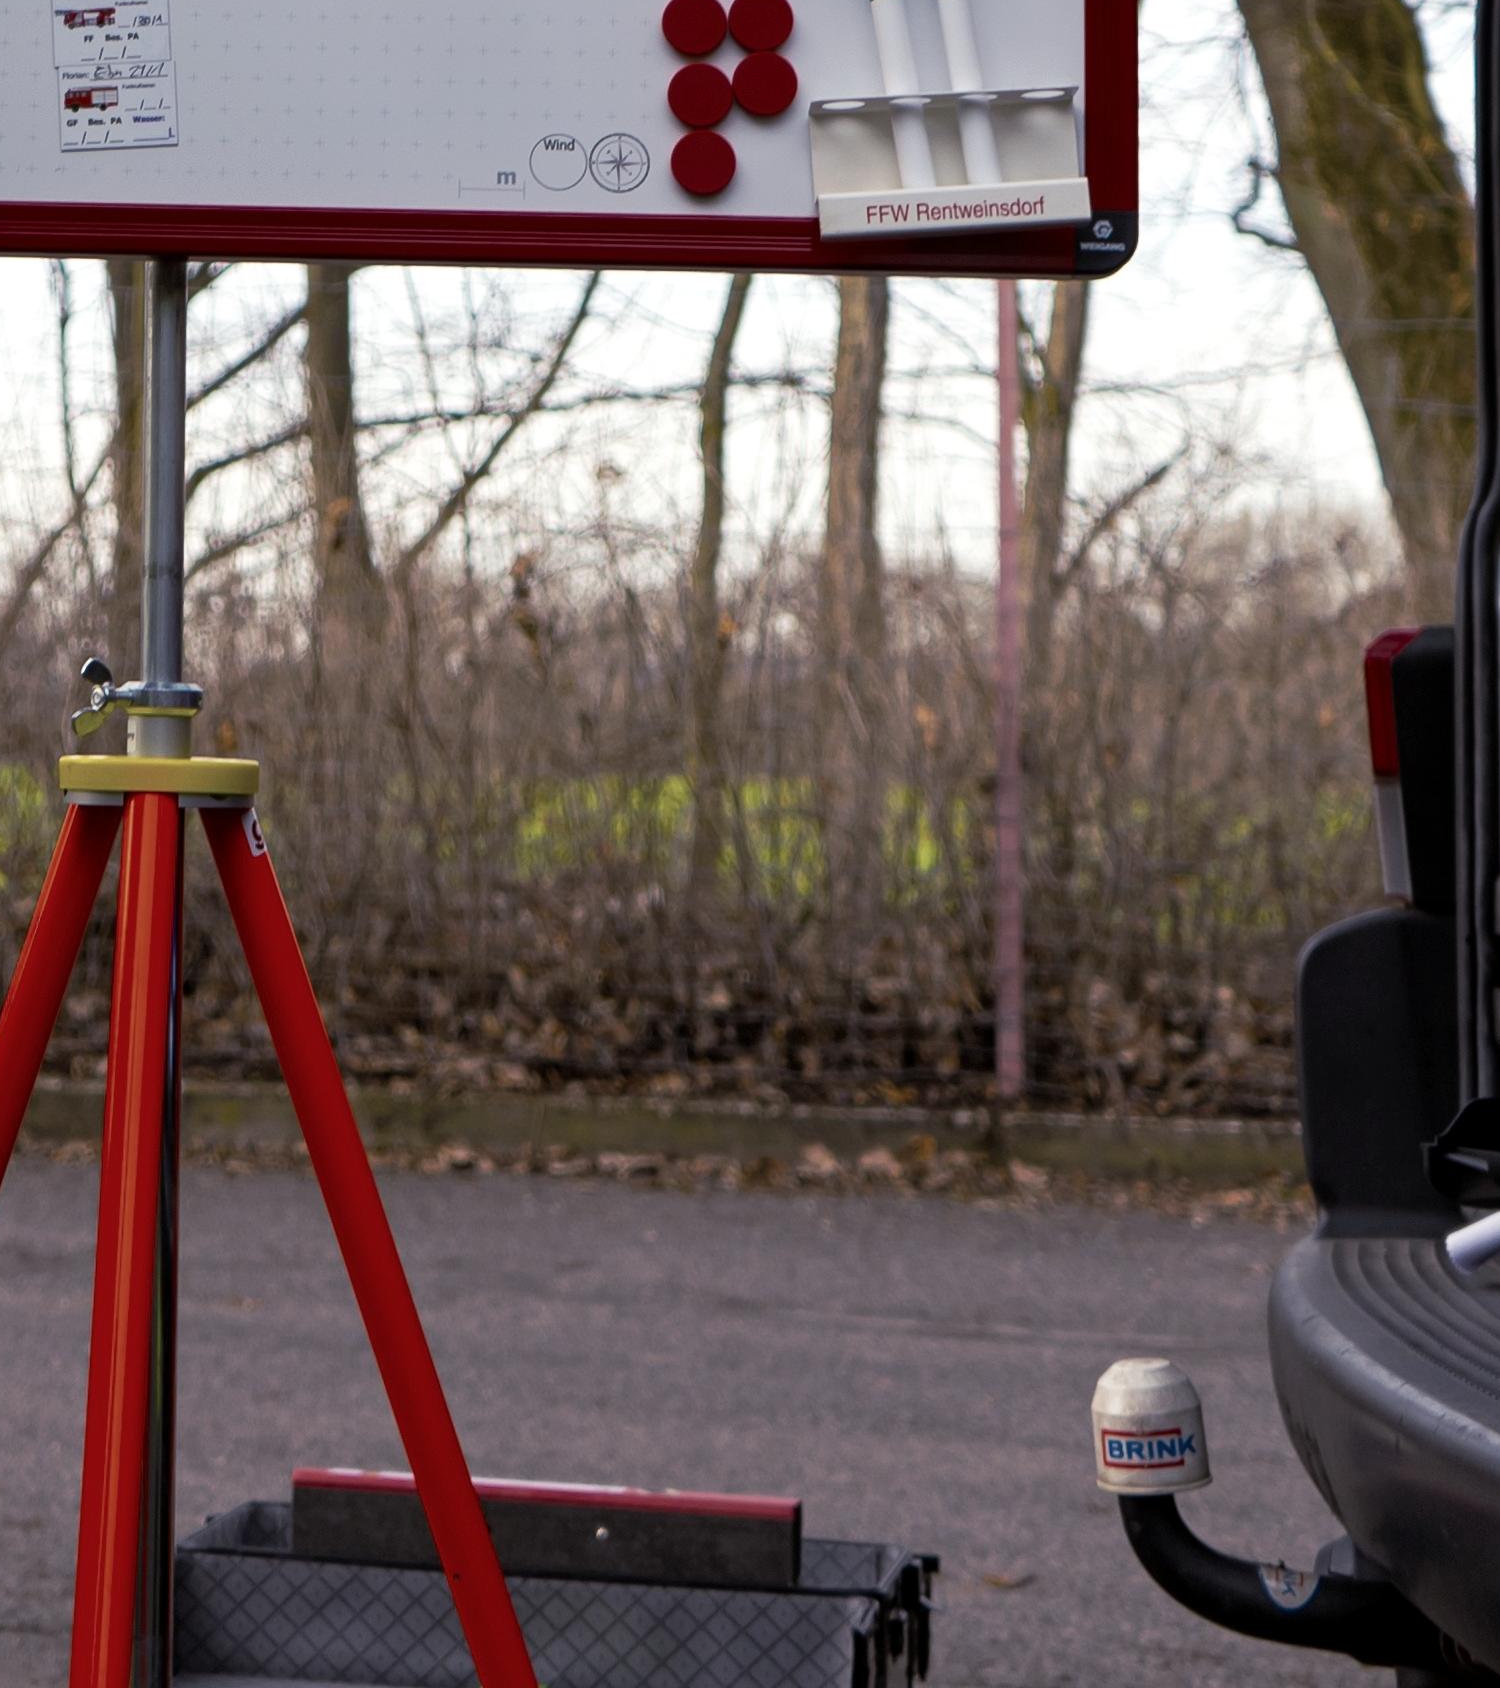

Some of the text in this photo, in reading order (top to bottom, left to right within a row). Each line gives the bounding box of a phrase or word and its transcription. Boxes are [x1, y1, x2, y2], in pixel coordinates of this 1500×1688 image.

[543, 139, 576, 152] Wind
[496, 170, 517, 185] m
[866, 196, 1045, 224] FFW Rentweinsdorf
[1108, 1434, 1197, 1461] BRINK
